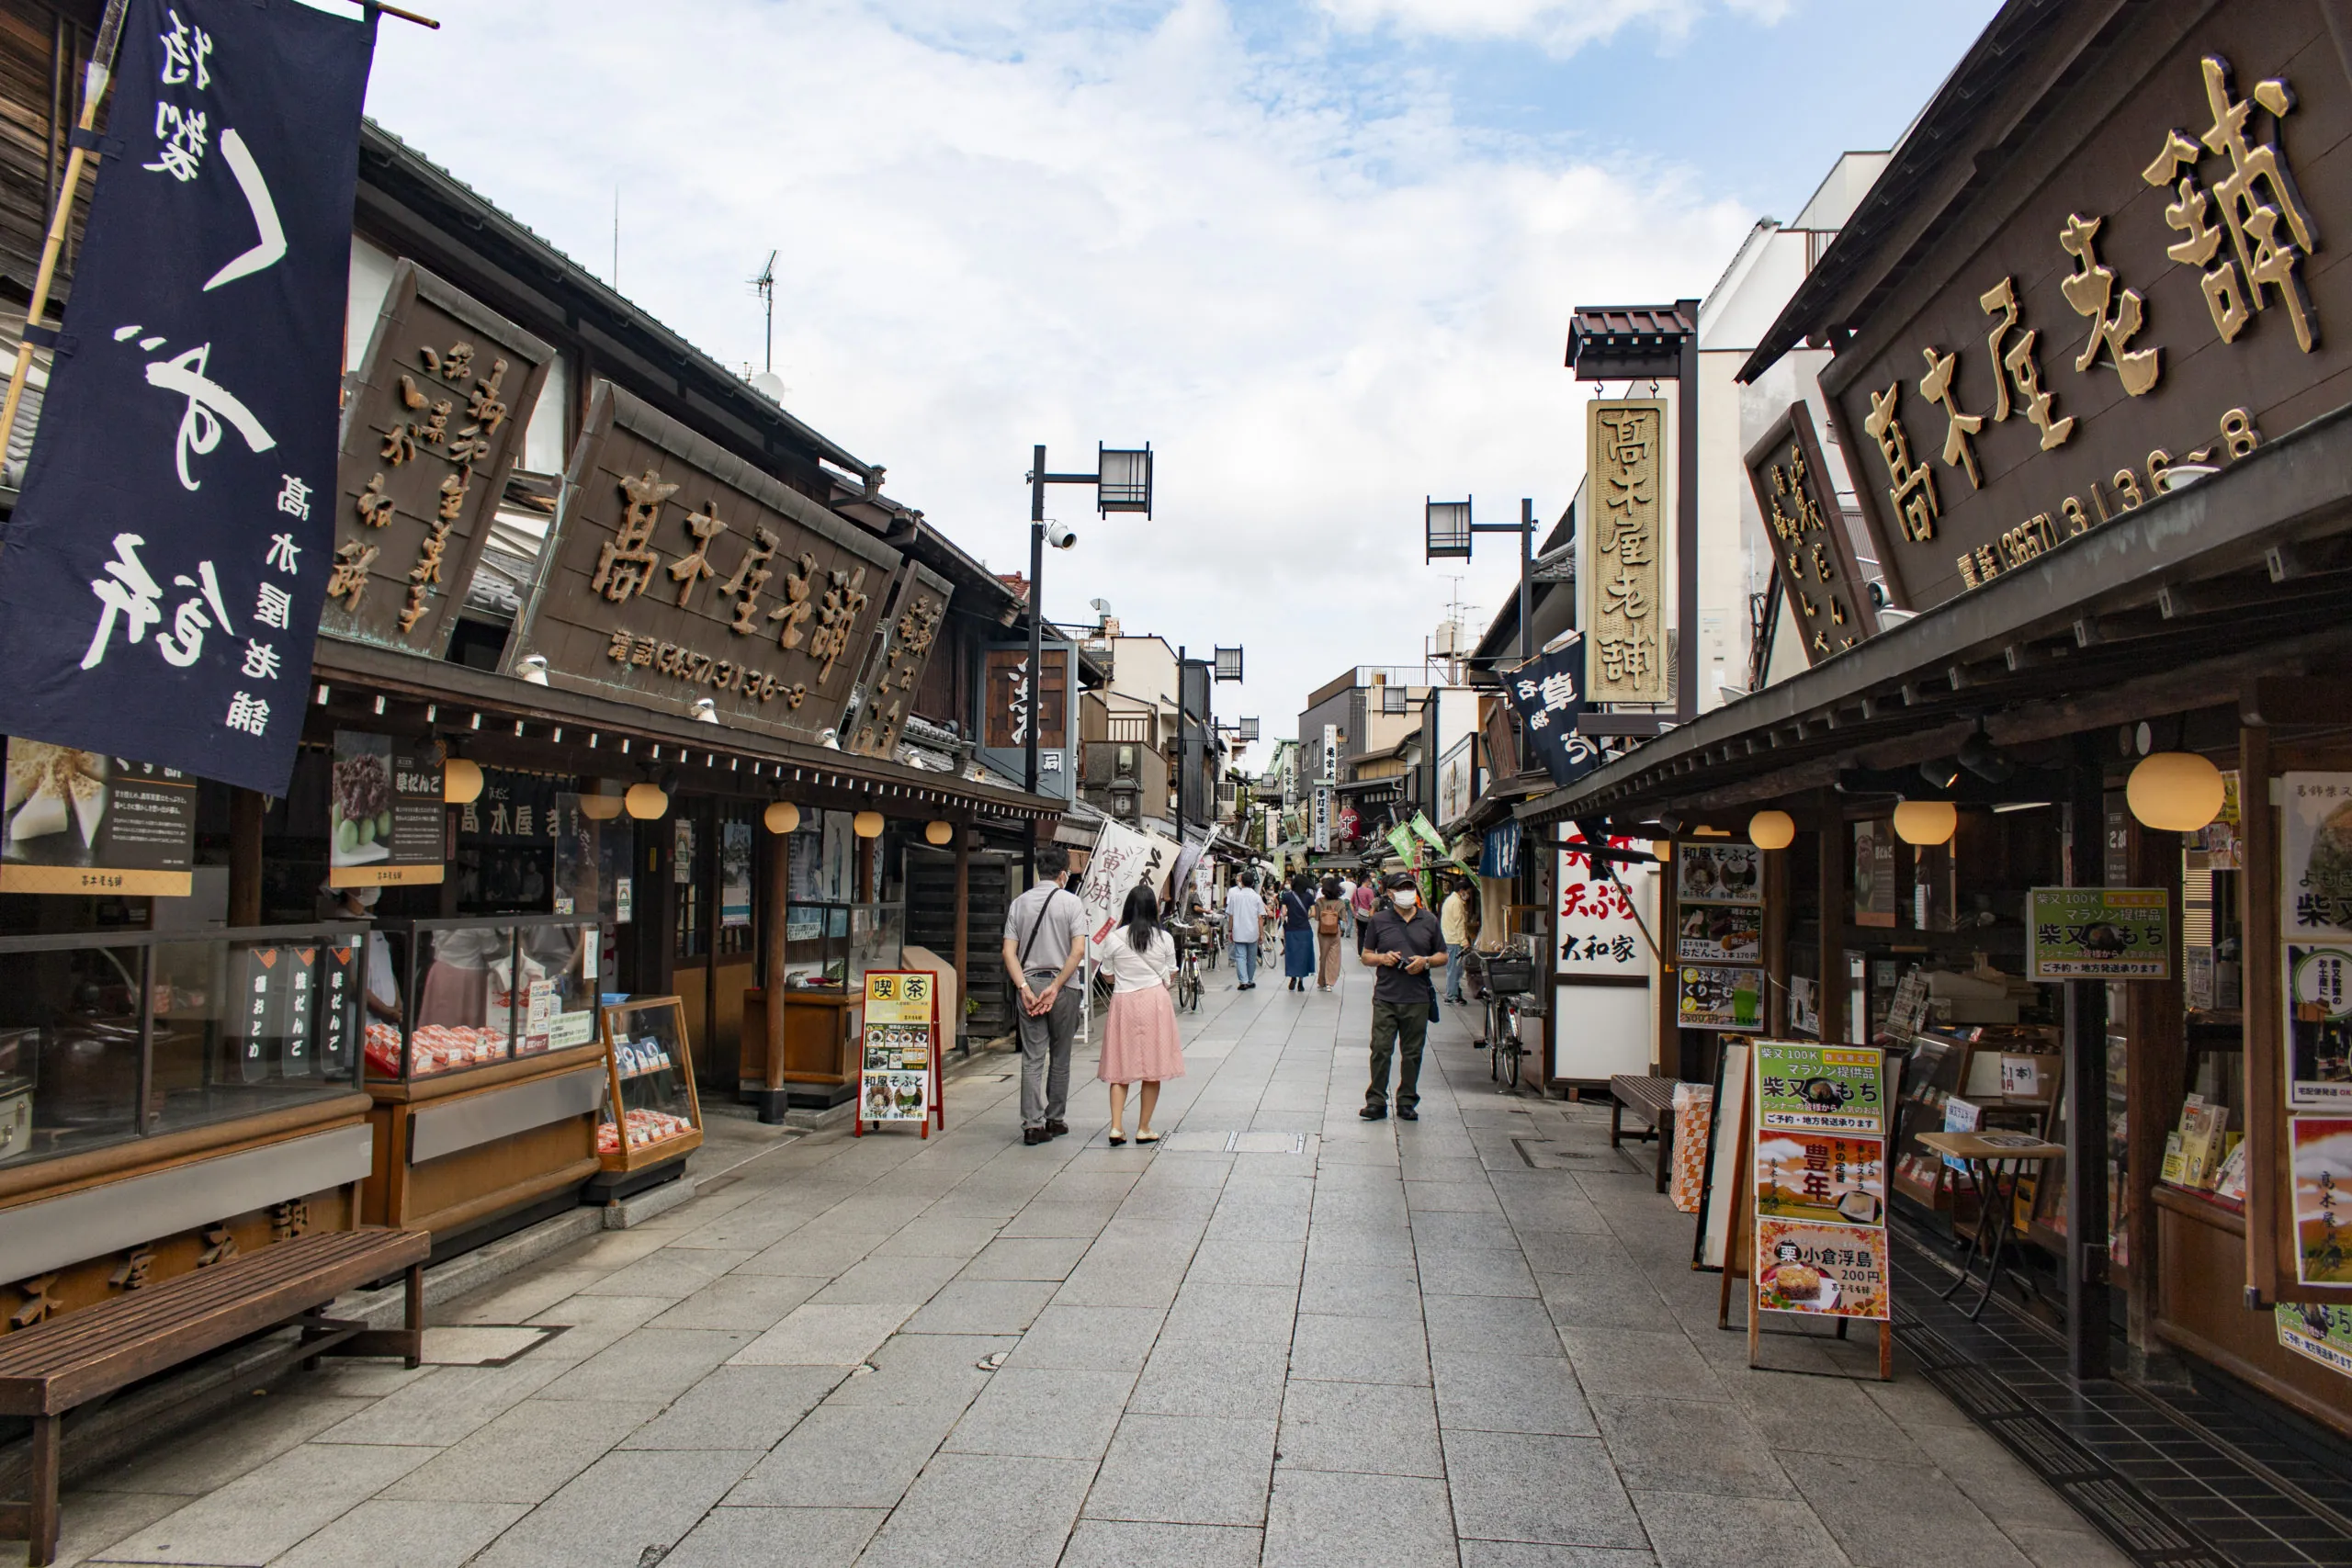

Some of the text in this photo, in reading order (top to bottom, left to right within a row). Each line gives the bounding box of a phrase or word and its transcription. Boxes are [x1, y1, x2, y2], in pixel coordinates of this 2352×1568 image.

[1865, 53, 2317, 542] 高木屋老舗
[1601, 410, 1656, 690] 高木屋老舗
[591, 468, 868, 685] 高木屋老舗
[396, 772, 441, 793] 草だんご
[1683, 847, 1757, 863] 和風そふと
[1561, 883, 1634, 919] 天ぷら
[2064, 908, 2161, 921] マラソン提供品
[1561, 933, 1636, 963] 大和家
[1681, 948, 1721, 959] おだんご
[2042, 963, 2158, 973] ご予約・地方発送承ります
[1685, 984, 1735, 998] くりーむ
[1683, 998, 1721, 1012] ソーダ
[1761, 1047, 1784, 1059] 柴又
[1788, 1064, 1875, 1080] マラソン提供品
[865, 1075, 923, 1089] 和風そふと
[1763, 1076, 1877, 1102] 柴又 もち
[1763, 1100, 1881, 1115] ランナーの皆様から人気のお品
[1767, 1113, 1874, 1128] ご予約・地方発送承ります
[1803, 1144, 1831, 1201] 豊年
[1804, 1247, 1871, 1268] 小倉浮島
